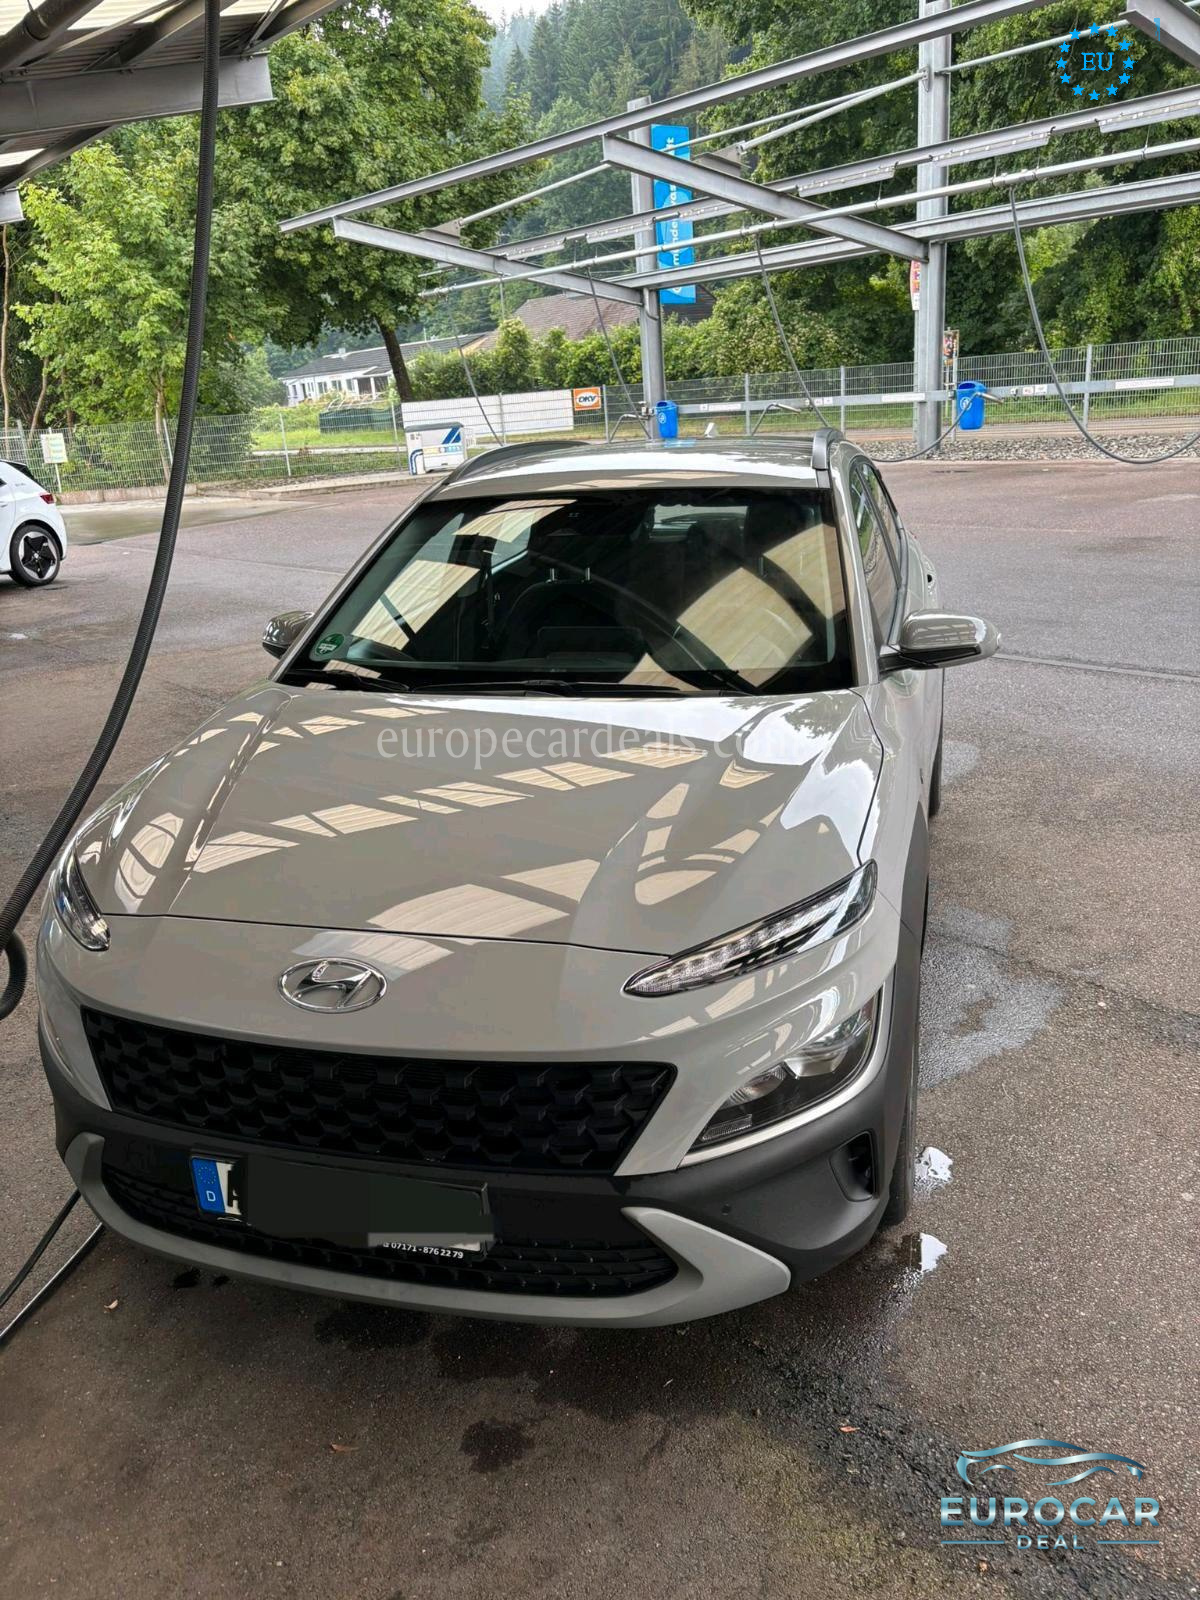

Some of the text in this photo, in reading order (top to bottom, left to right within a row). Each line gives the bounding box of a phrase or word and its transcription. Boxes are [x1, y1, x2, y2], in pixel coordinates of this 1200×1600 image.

[206, 1190, 216, 1202] D
[391, 1242, 417, 1252] 07171
[423, 1246, 440, 1255] 876
[440, 1249, 452, 1257] 22
[452, 1250, 464, 1259] 79
